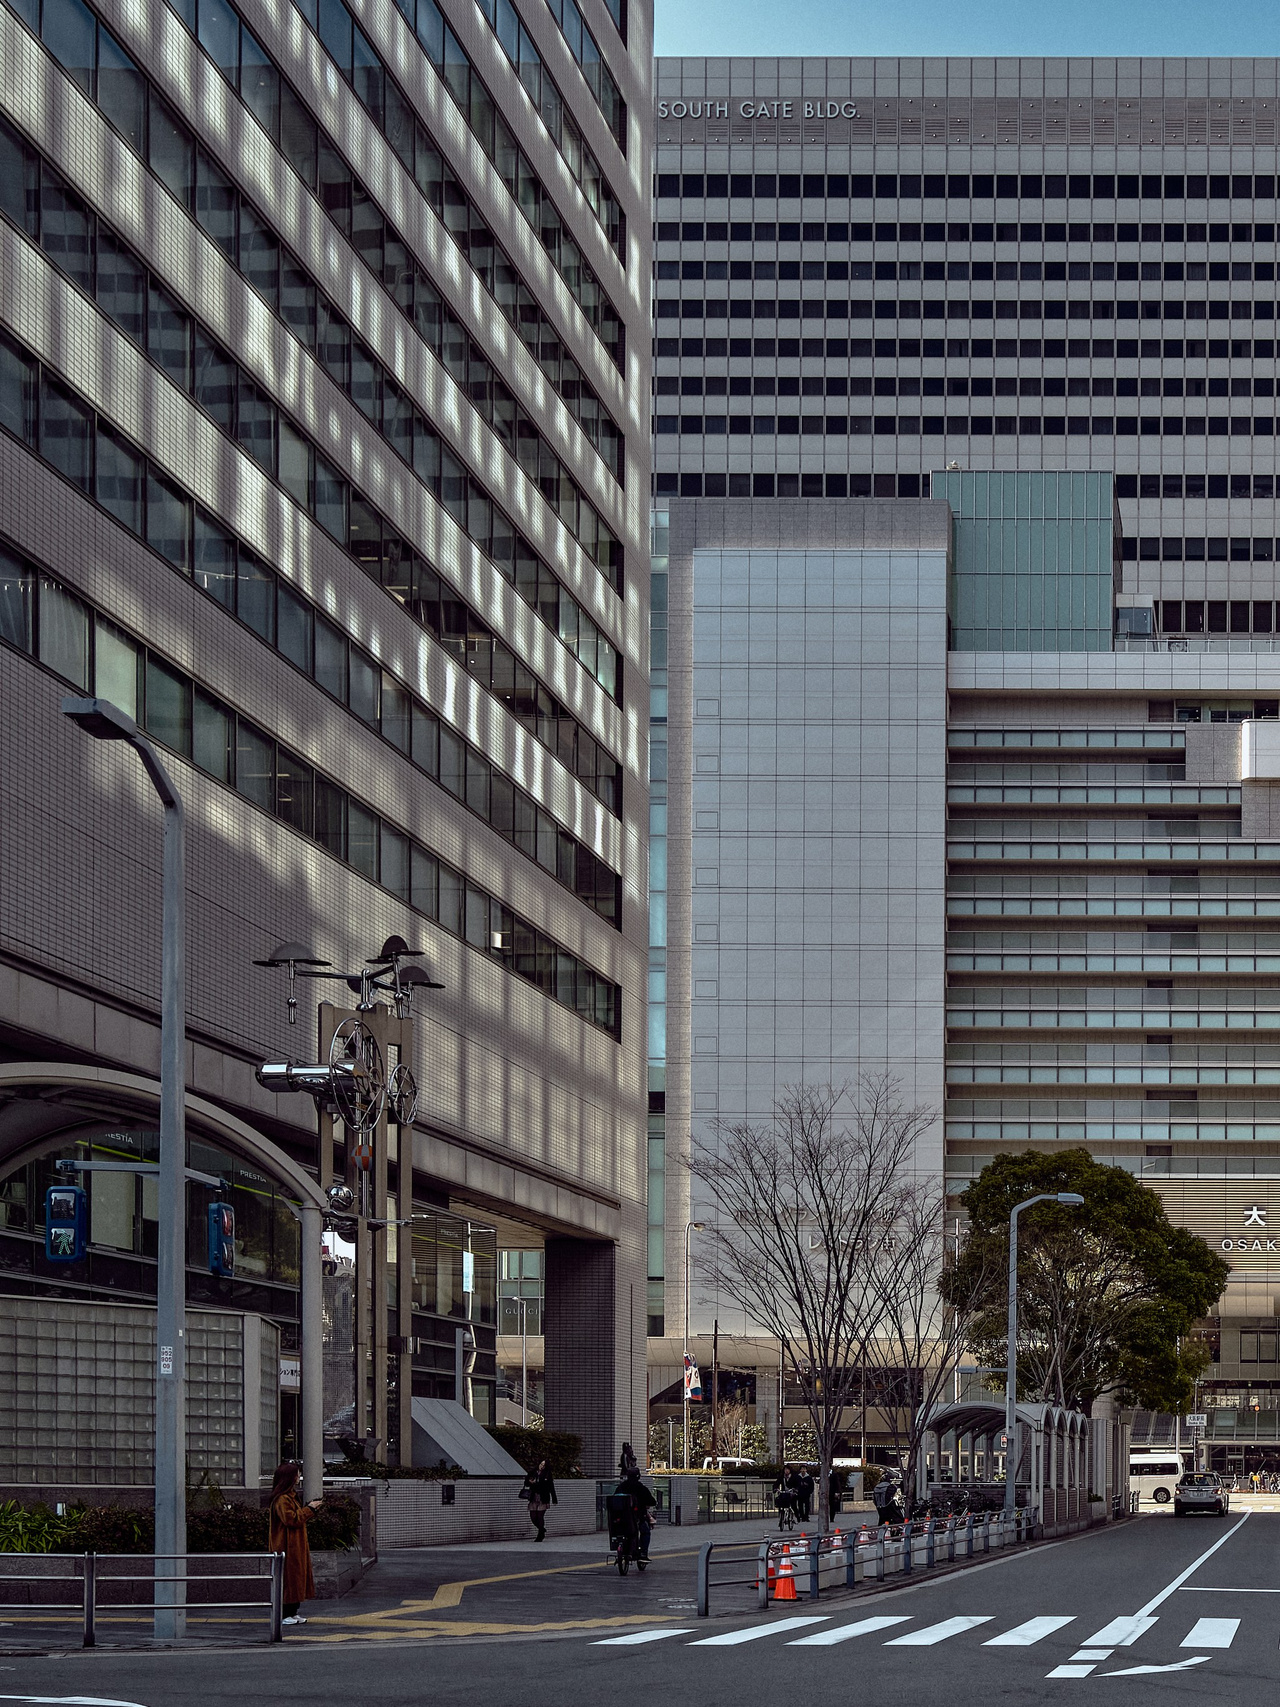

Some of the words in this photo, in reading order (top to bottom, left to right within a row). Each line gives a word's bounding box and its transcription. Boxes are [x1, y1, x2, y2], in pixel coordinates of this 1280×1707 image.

[658, 101, 729, 119] SOUTH
[740, 101, 793, 119] GATE
[804, 101, 861, 119] BLDG.
